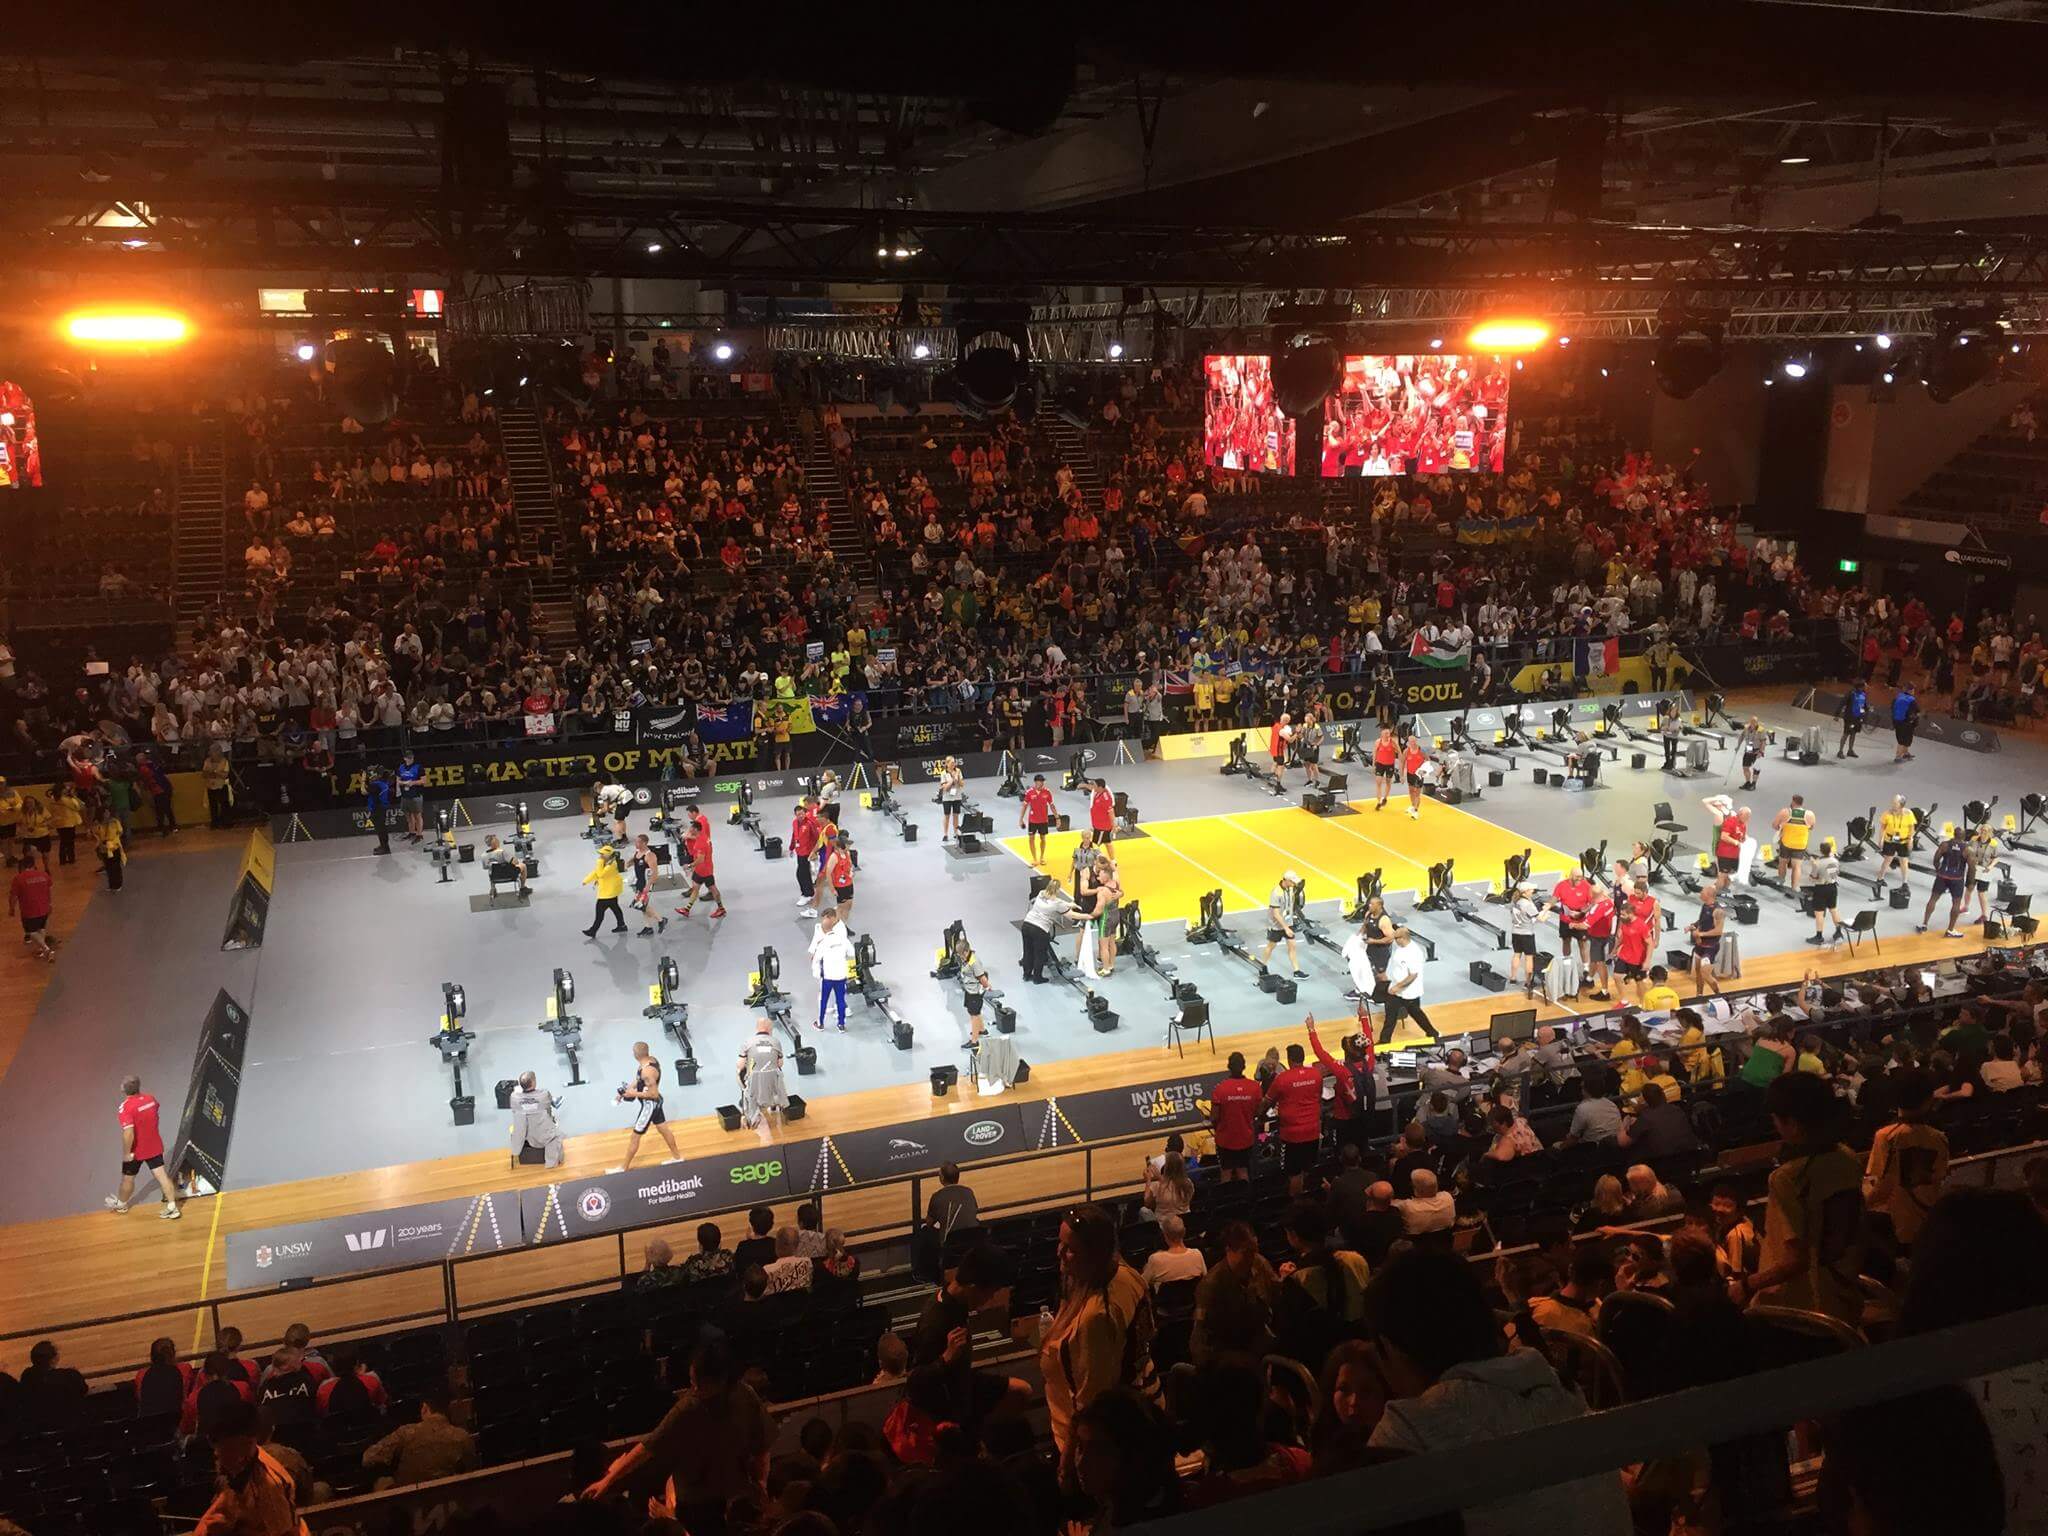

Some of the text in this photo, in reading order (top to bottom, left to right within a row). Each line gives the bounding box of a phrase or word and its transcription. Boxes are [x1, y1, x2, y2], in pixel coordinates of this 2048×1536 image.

[1407, 683, 1463, 702] SOUL
[603, 751, 641, 772] OF
[1131, 1083, 1203, 1106] INVICTUS
[1139, 1098, 1194, 1118] GAMES
[972, 1125, 994, 1135] LAND
[974, 1130, 998, 1141] ROVER
[888, 1149, 929, 1161] JAGUAR
[730, 1160, 783, 1185] sage
[638, 1175, 703, 1199] medibank
[398, 1227, 416, 1237] 200
[416, 1223, 442, 1236] years
[275, 1241, 313, 1257] UNSW
